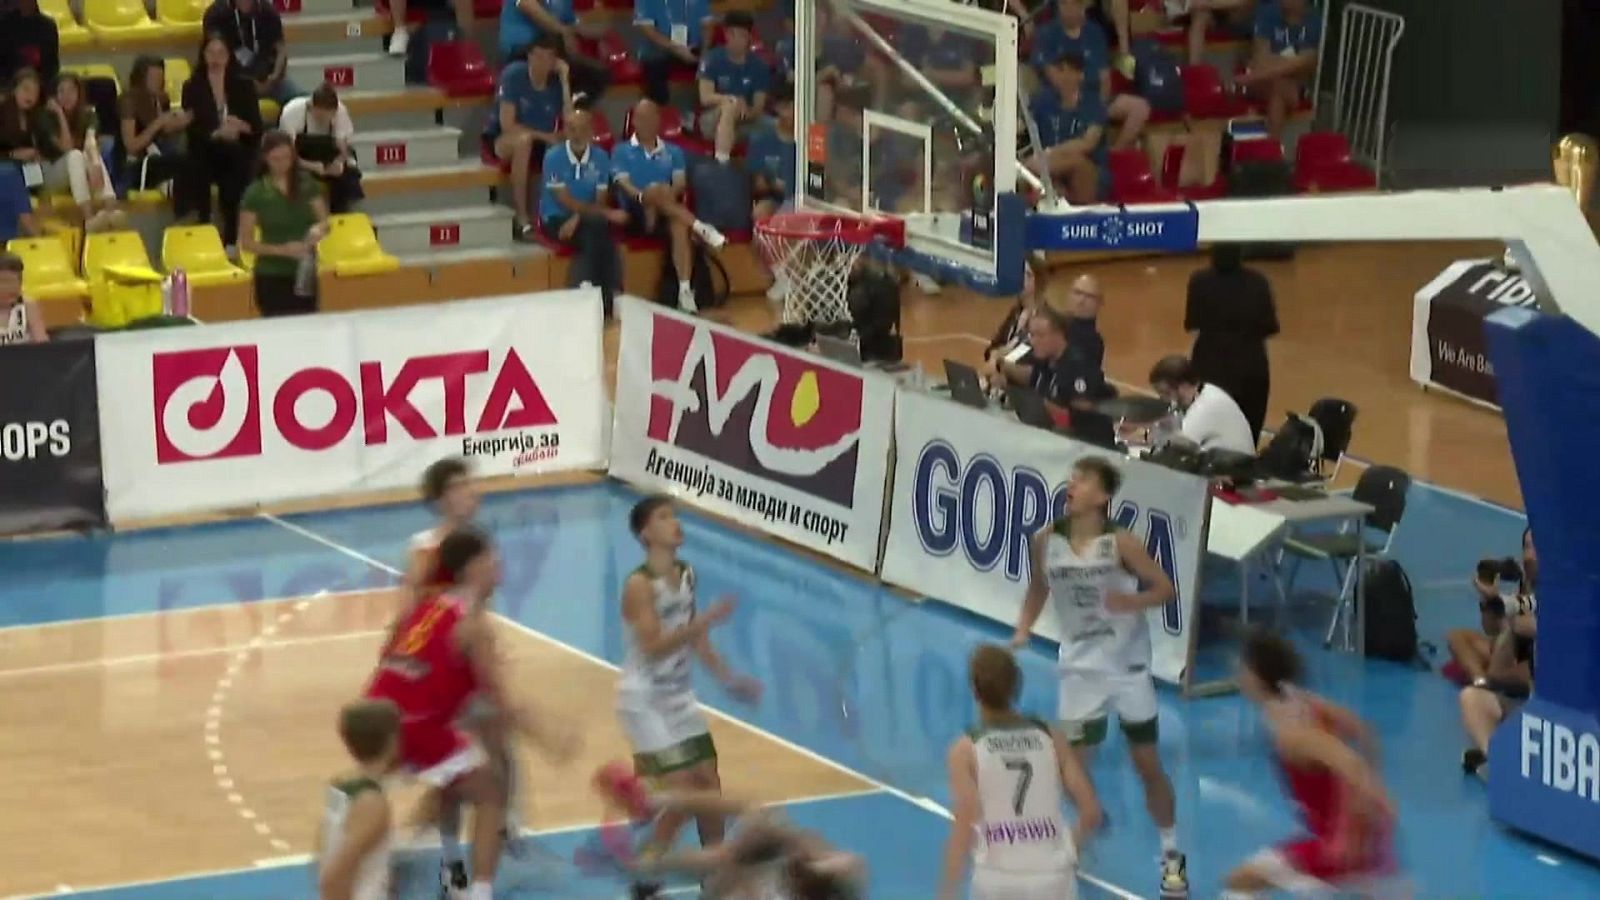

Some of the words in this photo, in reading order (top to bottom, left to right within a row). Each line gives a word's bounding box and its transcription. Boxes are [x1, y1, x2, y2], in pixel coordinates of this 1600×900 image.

[332, 70, 346, 83] IV
[384, 147, 400, 160] III
[440, 229, 451, 241] II
[1062, 224, 1099, 240] SURE
[1127, 222, 1164, 236] SHOT
[1438, 339, 1456, 363] We
[1457, 348, 1475, 371] Are
[462, 430, 534, 457] Енергија
[540, 433, 560, 448] за
[646, 447, 715, 497] Агенција
[717, 477, 734, 502] за
[735, 484, 788, 523] млади
[789, 504, 801, 527] и
[803, 508, 849, 545] спорт
[1521, 712, 1600, 804] FIBA
[1003, 759, 1033, 817] 7
